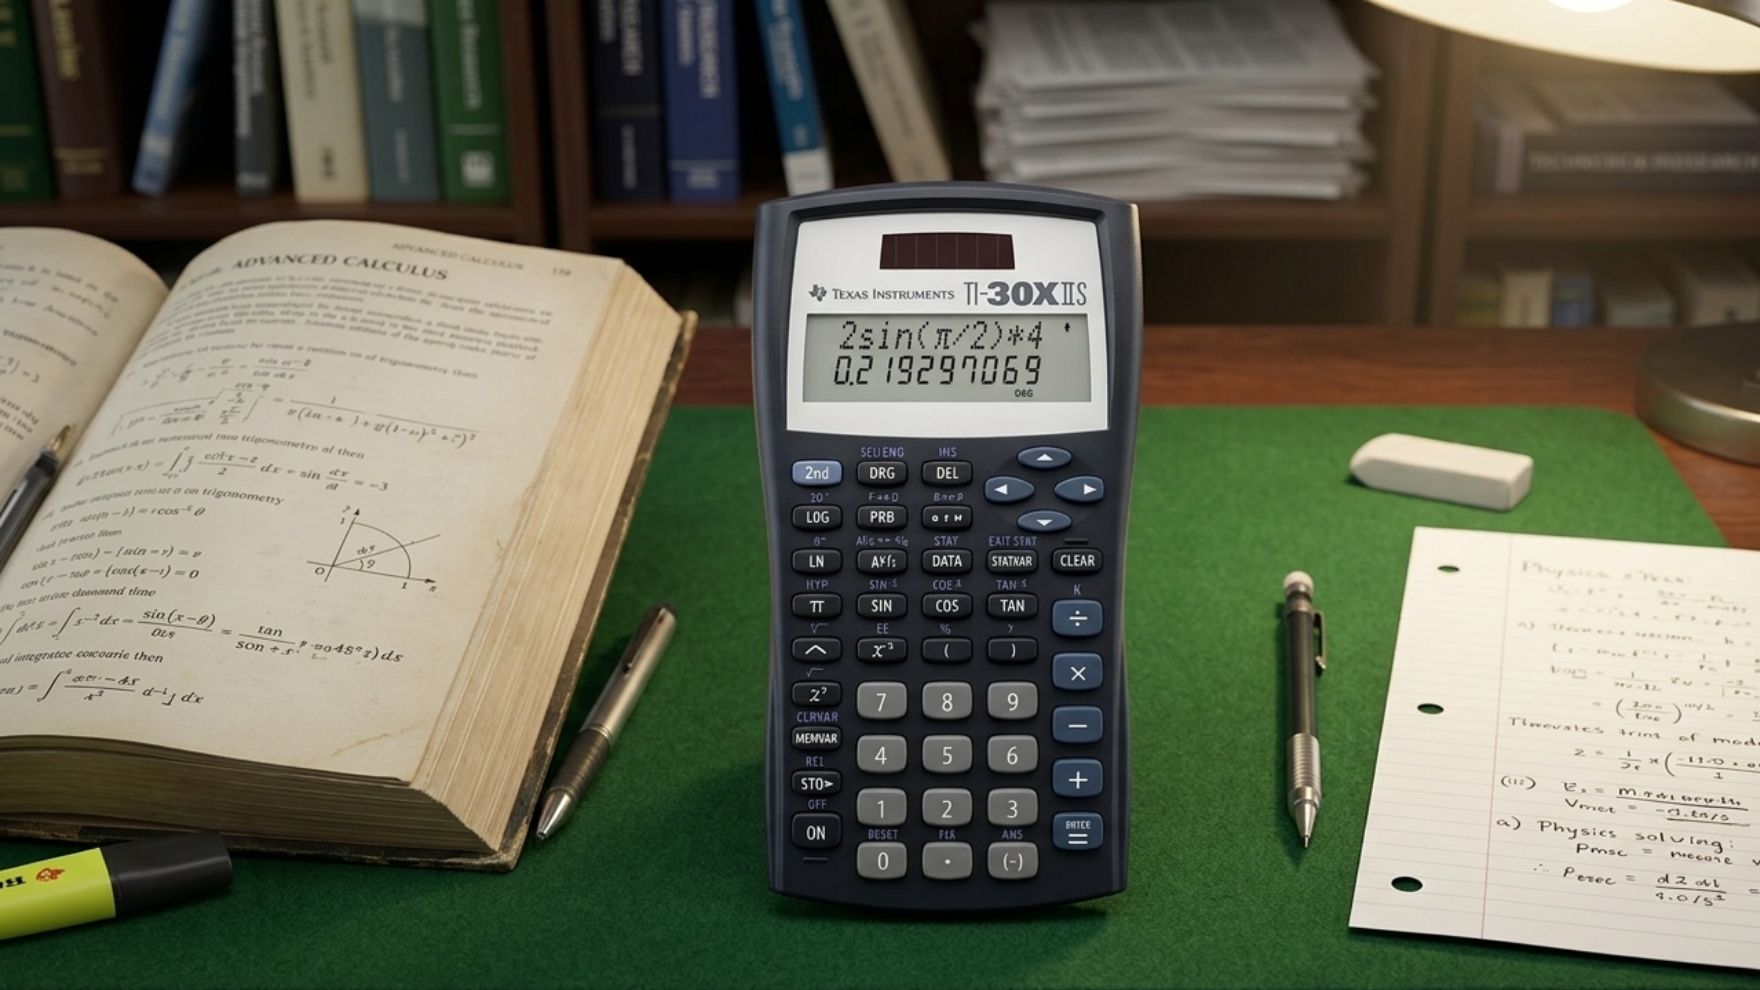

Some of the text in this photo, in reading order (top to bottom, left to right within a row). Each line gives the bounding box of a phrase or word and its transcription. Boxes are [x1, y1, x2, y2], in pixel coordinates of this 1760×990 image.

[232, 254, 449, 281] ADVANCED CALCULUS
[832, 288, 869, 300] TEXAS
[872, 288, 956, 300] INSTRUMENTS
[833, 355, 1042, 386] 0.219297069
[804, 465, 830, 480] 2nd
[868, 466, 896, 480] DRG
[936, 466, 960, 480] DEL
[805, 510, 831, 524] LOG
[869, 510, 896, 524] PRB
[808, 554, 825, 568] LN
[932, 554, 963, 568] DATA
[1059, 554, 1096, 567] CLEAR
[806, 579, 829, 589] HYP
[871, 599, 893, 613] SIN
[935, 599, 960, 613] COS
[1000, 599, 1025, 613] TAN
[875, 692, 887, 712] 7
[941, 692, 953, 712] 8
[1007, 692, 1019, 711] 9
[874, 746, 888, 765] 4
[942, 746, 953, 765] 5
[1006, 746, 1019, 765] 6
[877, 800, 885, 819] 1
[941, 800, 953, 818] 2
[1006, 800, 1019, 819] 3
[806, 825, 826, 840] ON
[1001, 829, 1024, 840] ANS
[1537, 819, 1618, 840] Physics
[877, 851, 889, 870] 0
